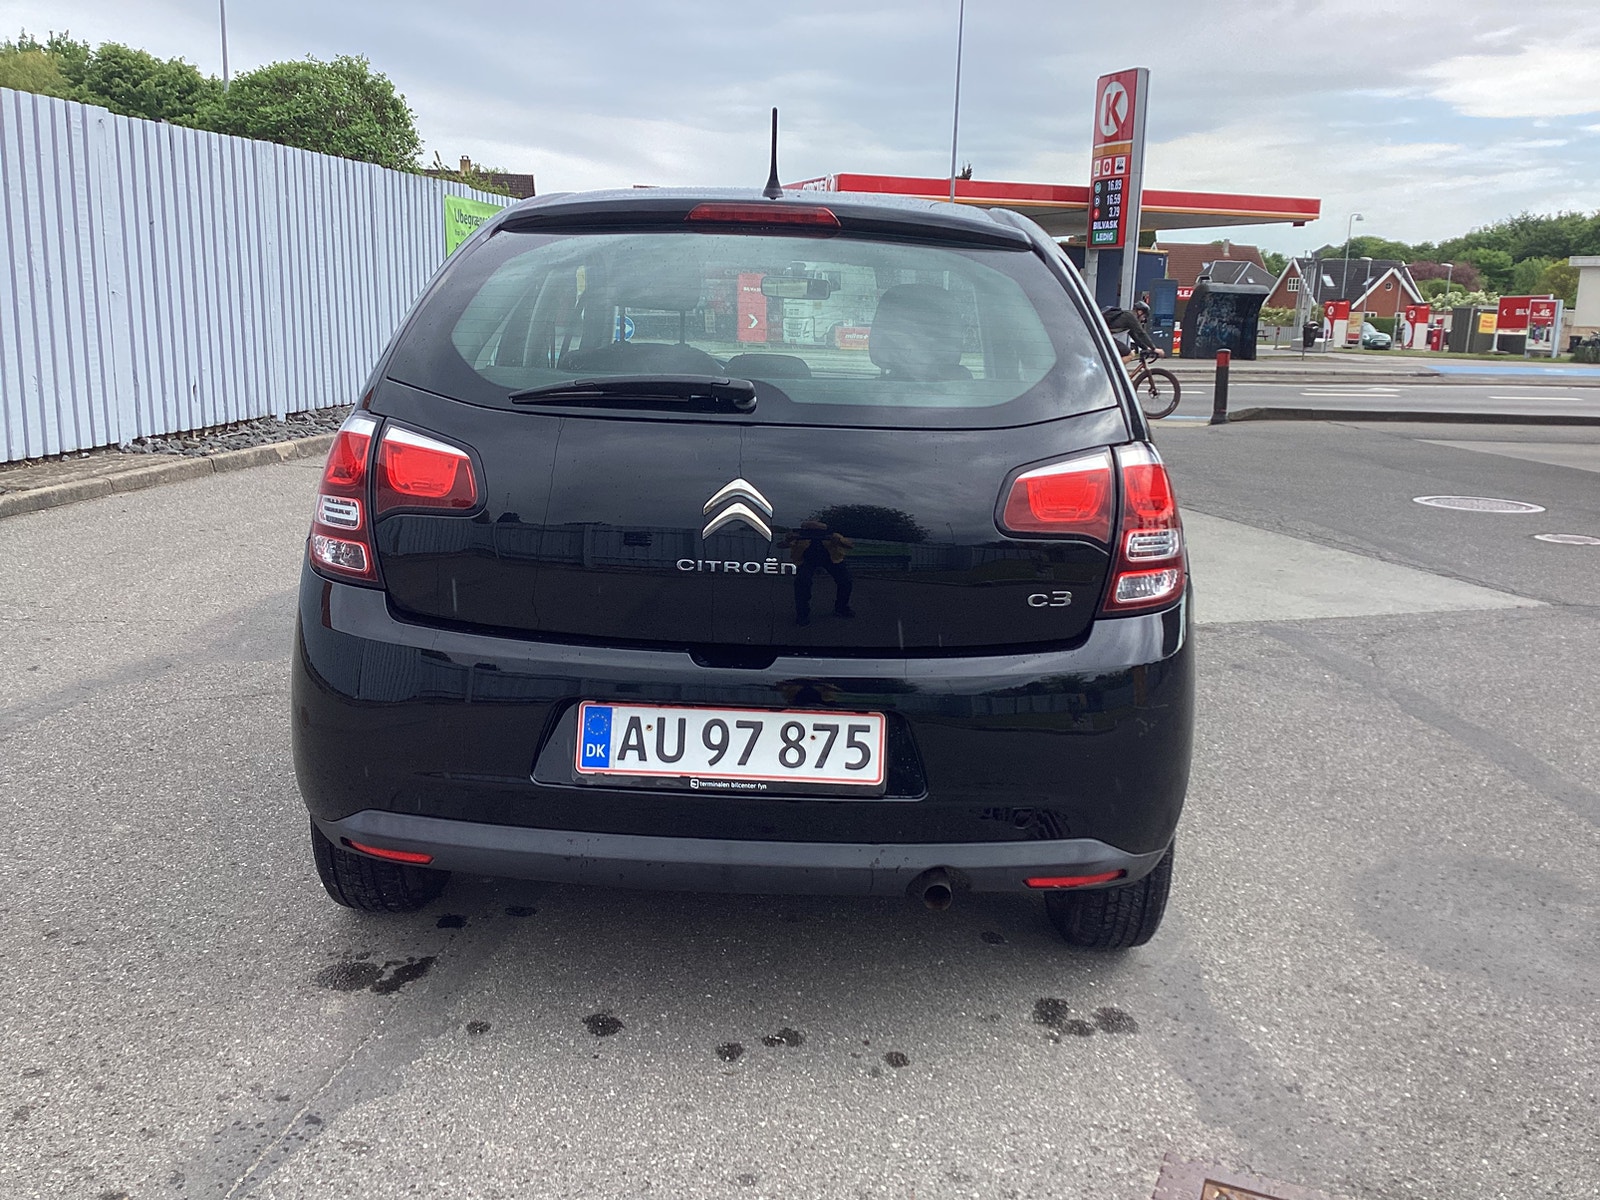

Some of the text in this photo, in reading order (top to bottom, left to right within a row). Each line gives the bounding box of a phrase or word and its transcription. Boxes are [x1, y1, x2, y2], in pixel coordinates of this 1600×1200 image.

[1092, 220, 1118, 230] BILVASK
[1095, 232, 1113, 241] LEDIG
[1027, 590, 1072, 607] C3
[617, 716, 871, 770] AU 97 875
[585, 743, 606, 758] DK
[757, 782, 767, 790] fyn
